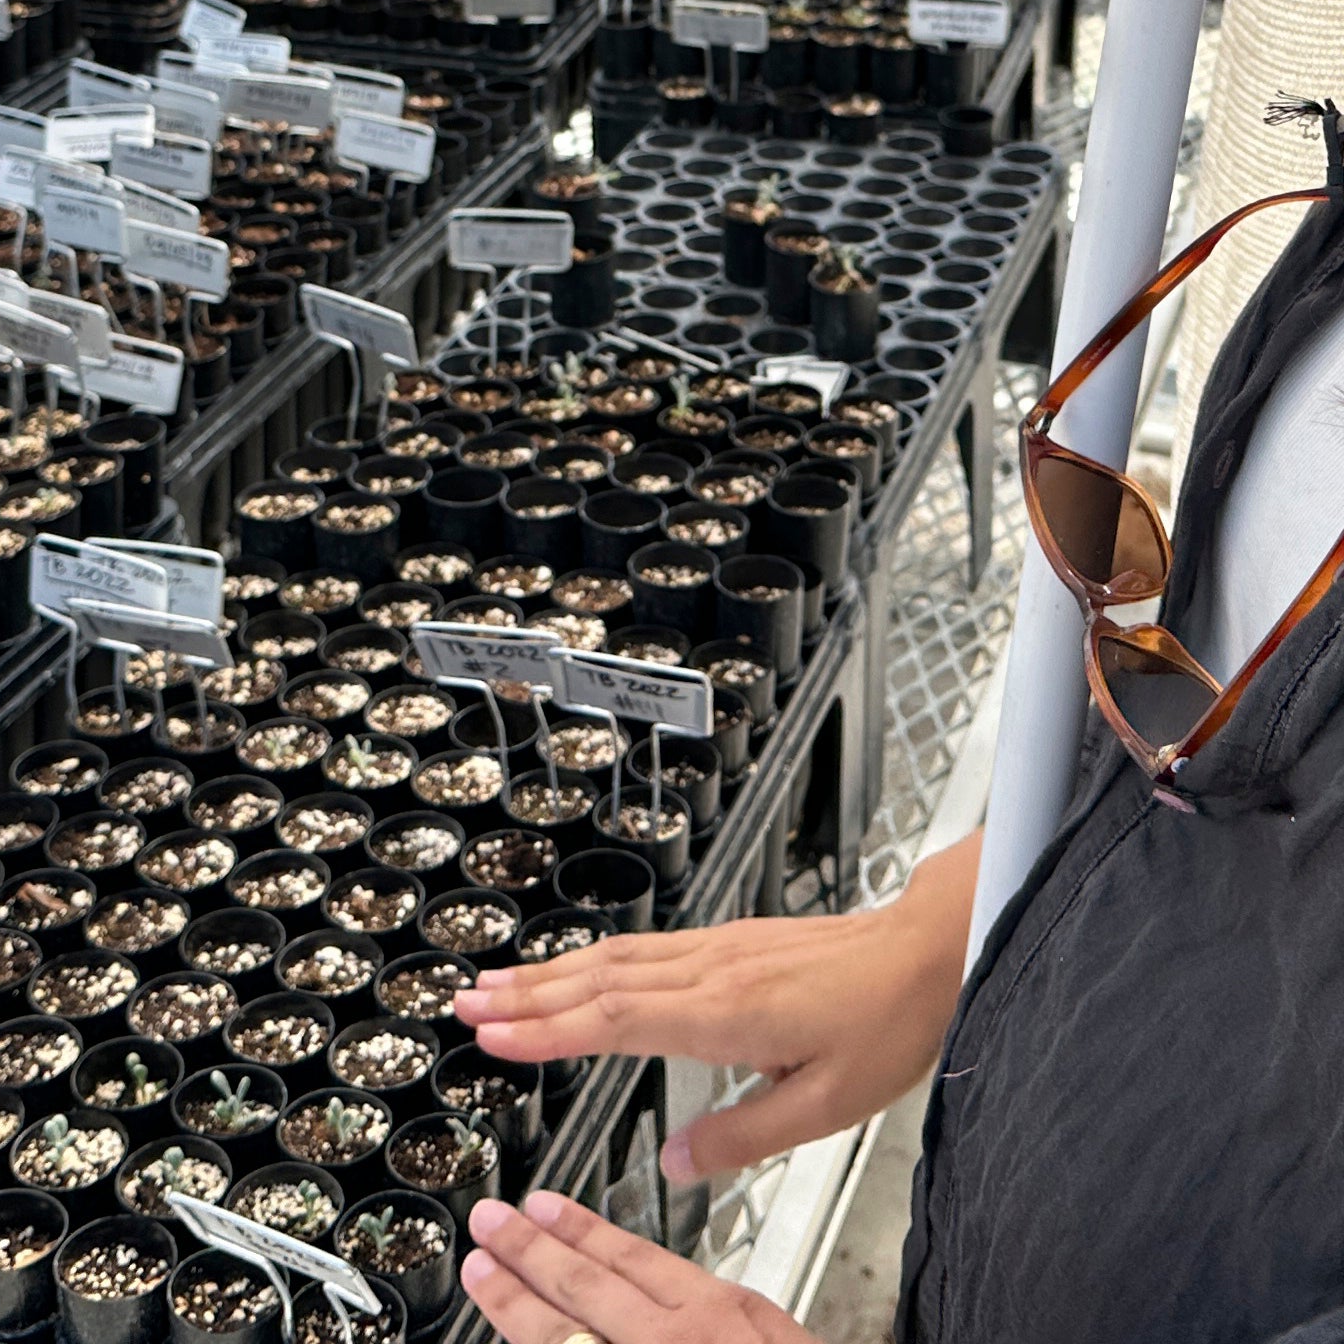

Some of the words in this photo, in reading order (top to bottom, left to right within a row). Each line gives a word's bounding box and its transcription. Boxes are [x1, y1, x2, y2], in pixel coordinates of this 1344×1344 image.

[440, 639, 475, 656] TB
[478, 642, 545, 662] 2022
[577, 667, 615, 688] TB
[621, 677, 688, 700] 2022
